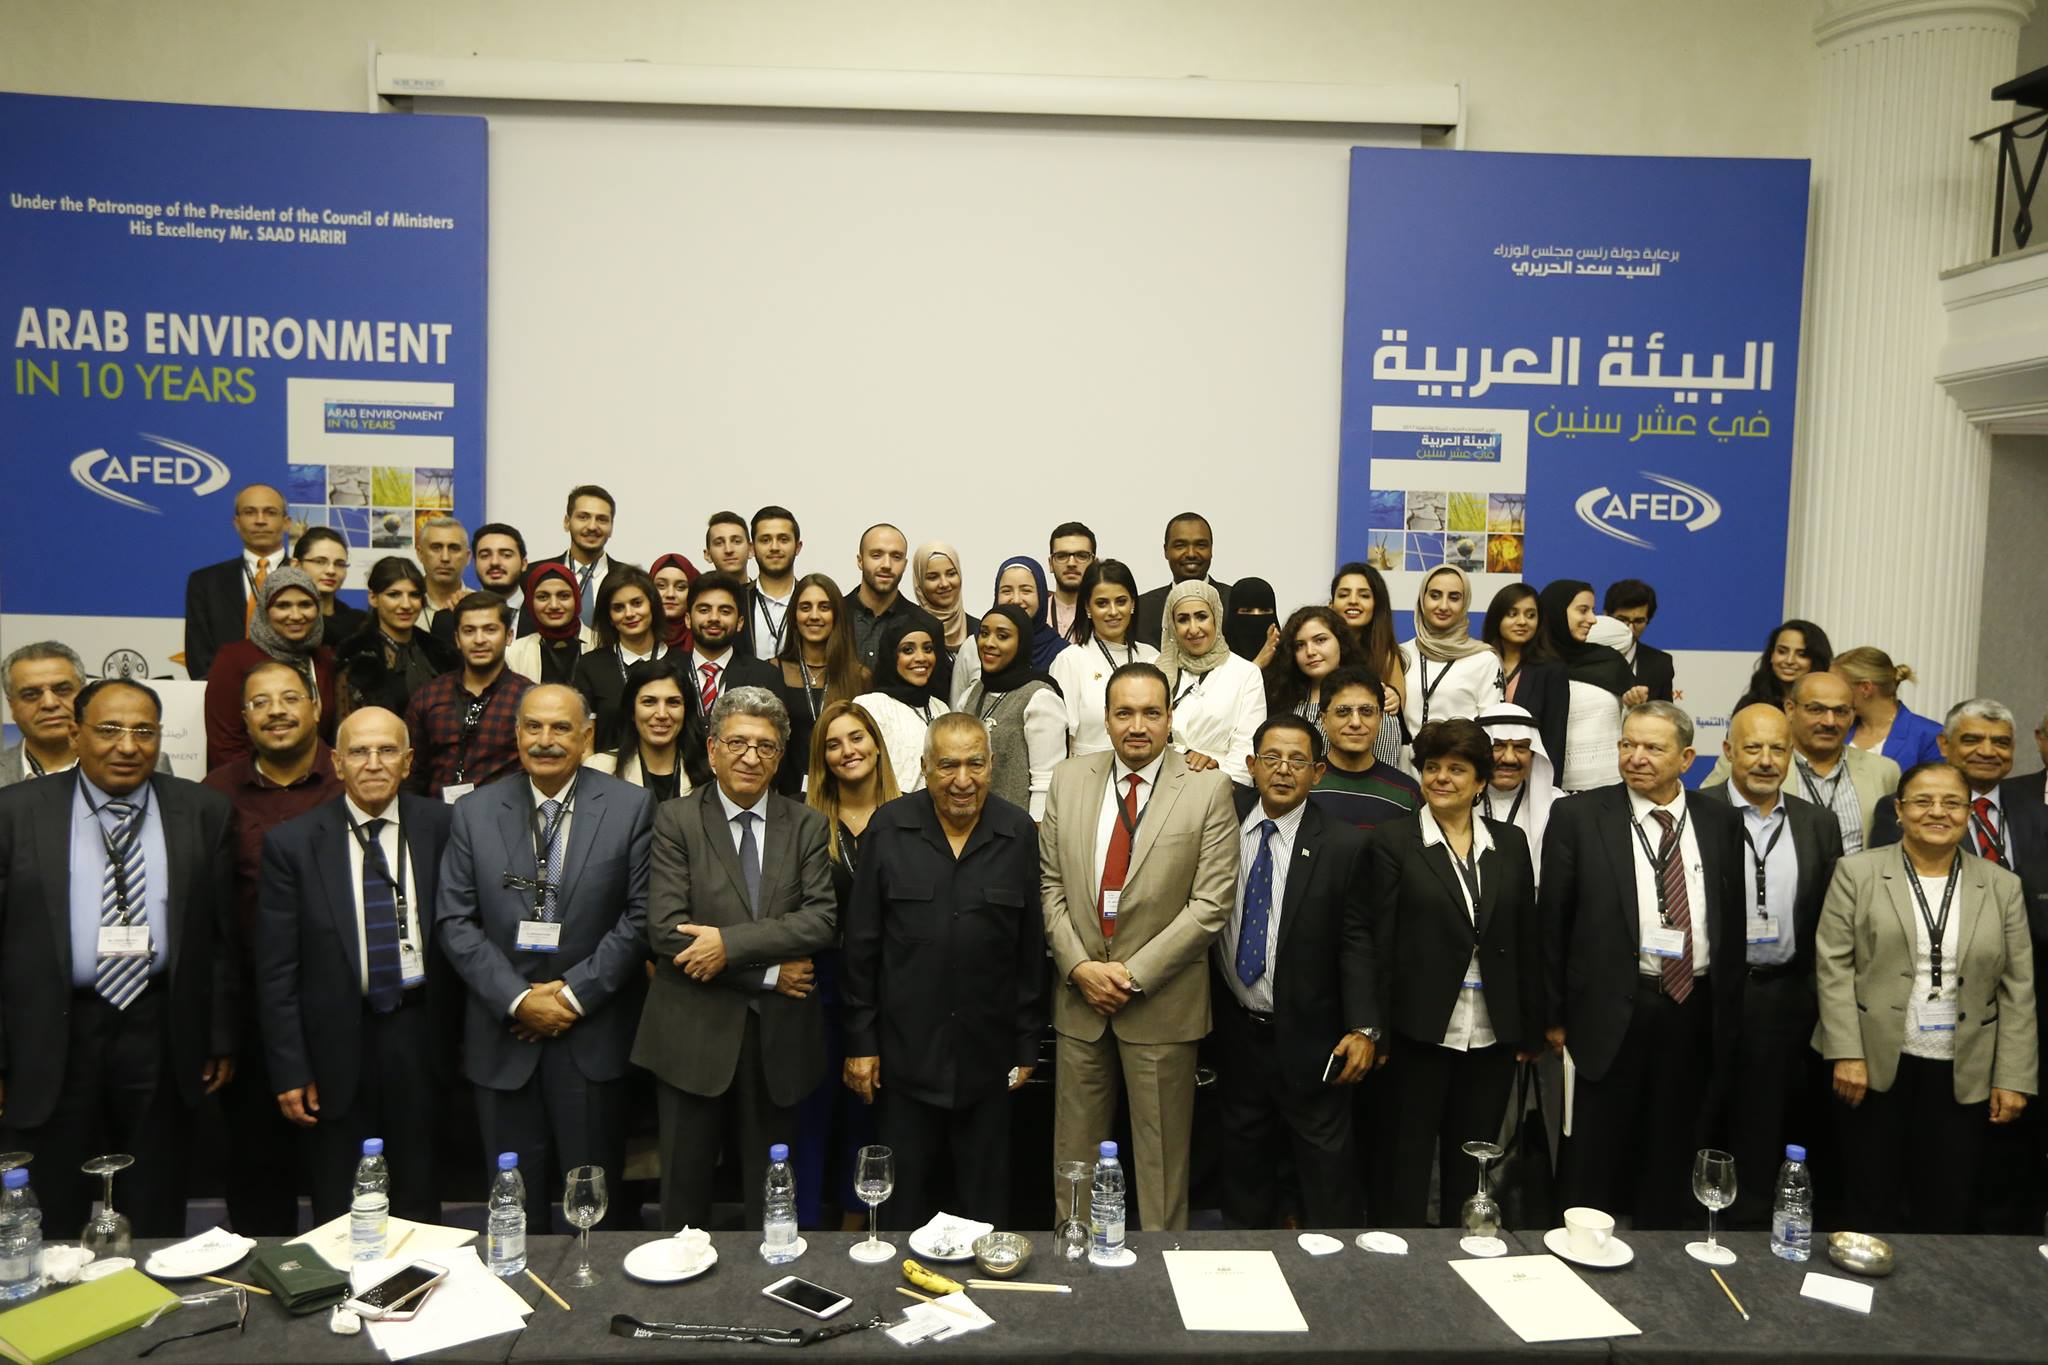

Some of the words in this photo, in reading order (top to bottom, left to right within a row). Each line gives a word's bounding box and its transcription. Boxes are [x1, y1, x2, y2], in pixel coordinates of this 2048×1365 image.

[11, 194, 56, 210] Under
[60, 196, 84, 212] the
[88, 198, 162, 219] Patronage
[166, 201, 180, 217] of
[184, 202, 207, 218] the
[210, 204, 276, 221] President
[279, 207, 293, 222] of
[297, 208, 319, 224] the
[323, 209, 372, 226] Council
[376, 211, 390, 227] of
[392, 213, 454, 230] Ministers
[130, 220, 153, 236] His
[156, 221, 226, 243] Excellency
[230, 225, 253, 240] Mr.
[257, 227, 296, 242] SAAD
[299, 229, 347, 245] HARIRI
[1493, 243, 1530, 259] الوزراء
[1532, 245, 1574, 261] مجلس
[1576, 246, 1608, 261] رئيس
[1610, 247, 1640, 261] دولة
[1642, 247, 1679, 263] برعاية
[1511, 260, 1573, 278] الحريري
[1575, 261, 1613, 276] سعد
[1615, 262, 1661, 279] السيد
[15, 307, 129, 352] ARAB
[146, 313, 453, 364] ENVIRONMENT
[1372, 328, 1581, 398] العربية
[1598, 331, 1774, 404] البيئة
[15, 358, 60, 396] IN
[76, 360, 125, 400] 10
[135, 364, 257, 405] YEARS
[327, 408, 357, 418] ARAB
[360, 408, 444, 421] ENVIRONMENT
[1534, 404, 1622, 439] سنين
[1630, 404, 1697, 442] عشر
[327, 420, 340, 428] IN
[362, 421, 396, 430] YEARS
[1707, 409, 1771, 442] في
[1421, 434, 1461, 448] العربية
[1463, 435, 1496, 450] البيئة
[101, 456, 202, 485] AFED
[1602, 493, 1694, 521] AFED
